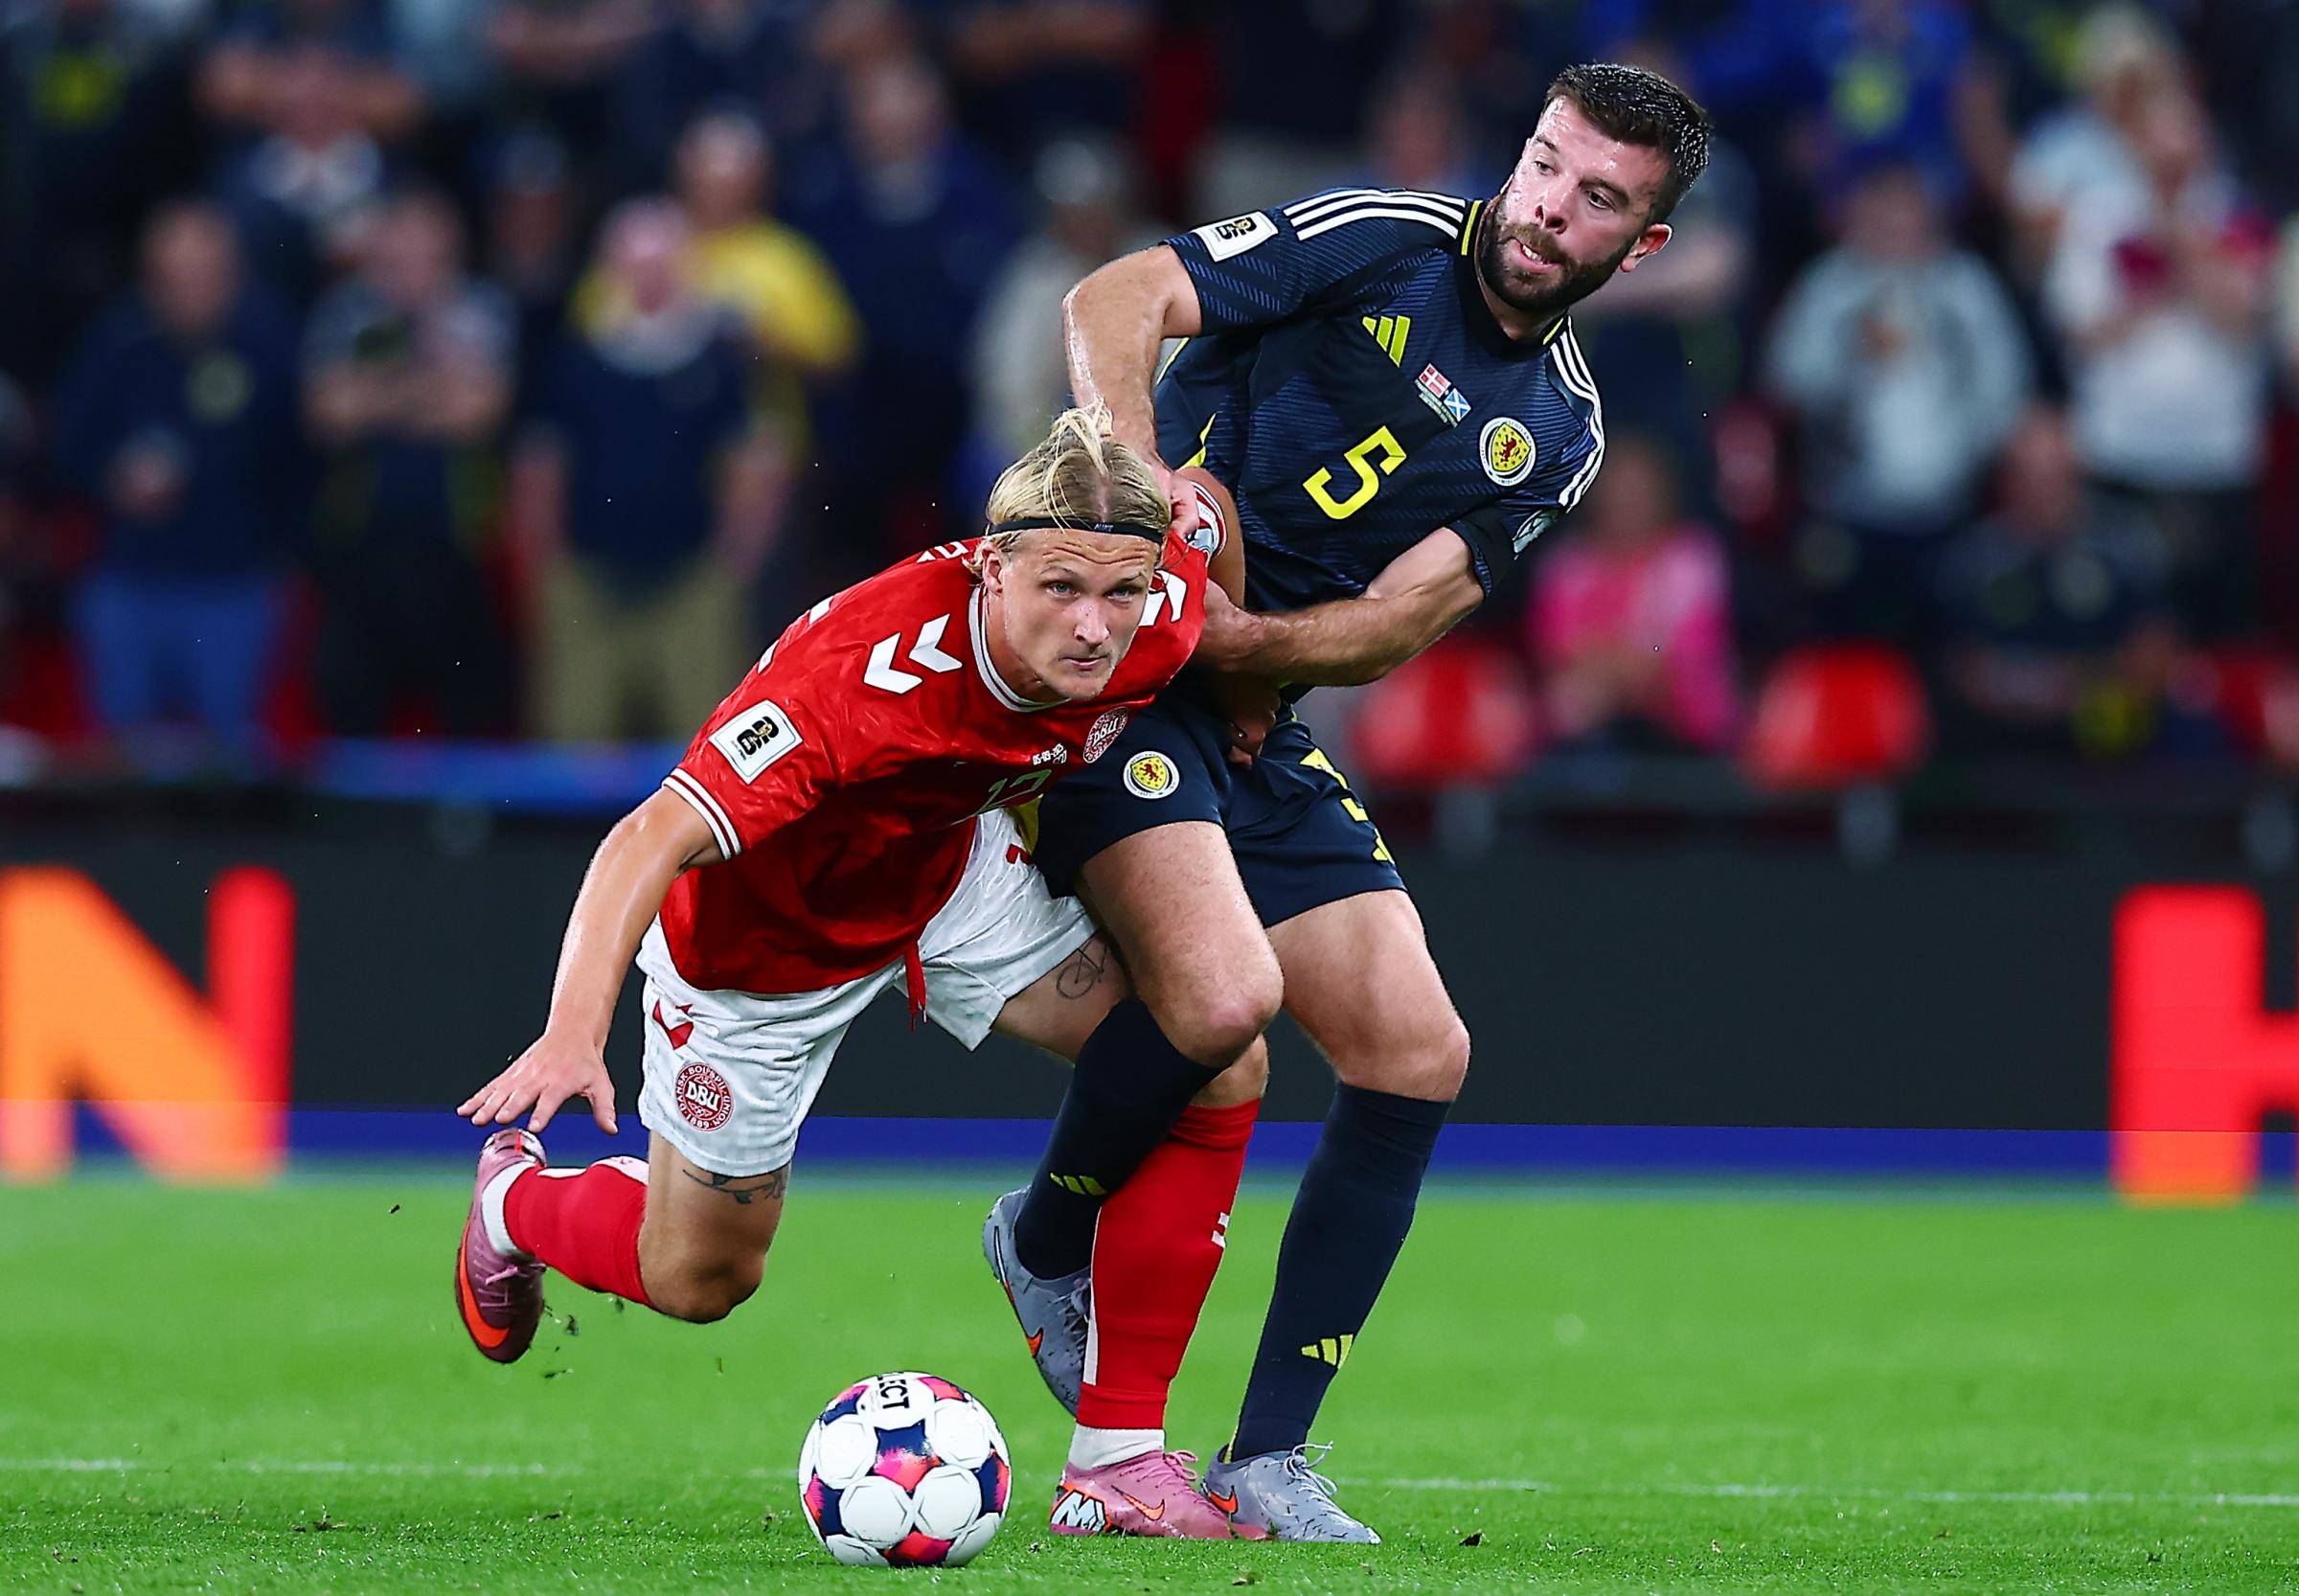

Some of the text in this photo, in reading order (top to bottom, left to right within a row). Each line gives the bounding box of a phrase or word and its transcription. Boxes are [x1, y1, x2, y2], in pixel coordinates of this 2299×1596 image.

[1303, 425, 1407, 519] 5
[1092, 718, 1119, 747] DBU
[685, 1081, 721, 1111] DBU
[713, 1095, 731, 1126] UNION
[686, 1113, 710, 1129] 1889
